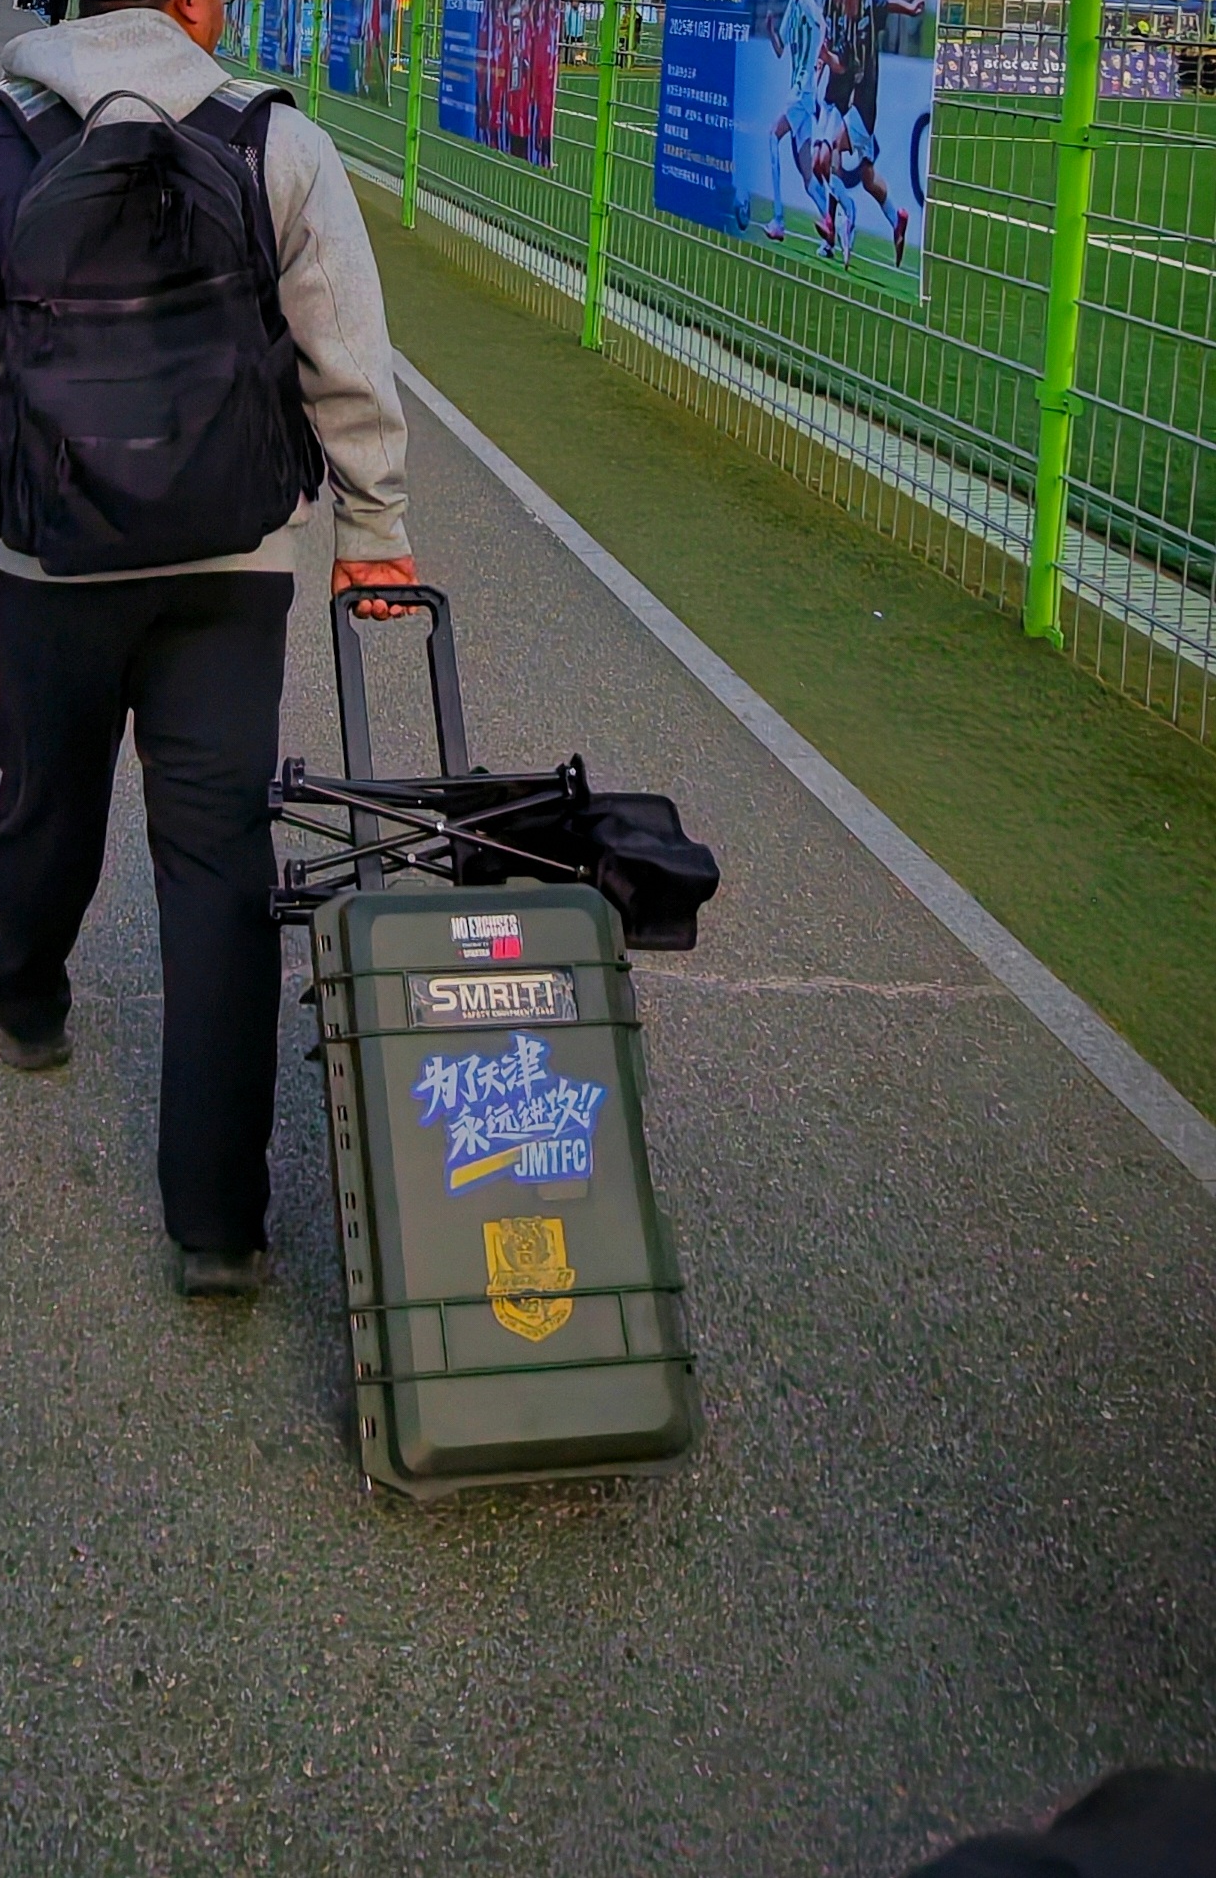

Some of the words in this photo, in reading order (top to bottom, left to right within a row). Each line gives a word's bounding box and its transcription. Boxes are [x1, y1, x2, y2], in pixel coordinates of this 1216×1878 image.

[451, 917, 469, 941] NO
[428, 973, 556, 1012] SMRITI
[417, 1034, 547, 1120] 为了天津
[514, 1138, 586, 1177] JMTFC
